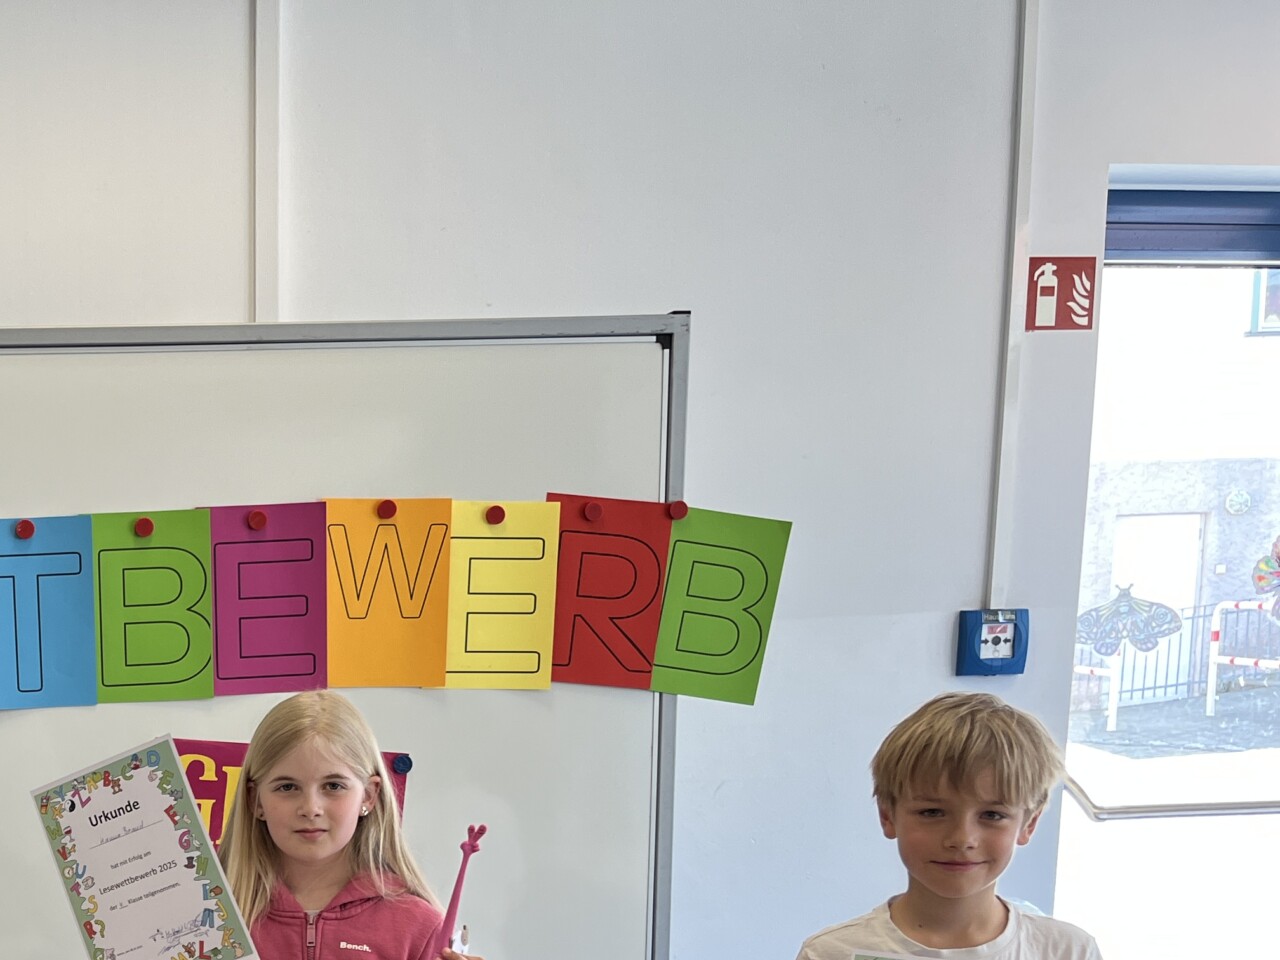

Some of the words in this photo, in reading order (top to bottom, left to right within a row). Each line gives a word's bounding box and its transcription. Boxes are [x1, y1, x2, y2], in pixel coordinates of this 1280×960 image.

[89, 800, 140, 827] Urkunde
[119, 859, 128, 867] mit
[128, 855, 143, 864] Erfolg
[143, 851, 151, 859] am
[99, 868, 157, 895] Lesewettbewerb
[159, 860, 177, 873] 2025
[128, 896, 143, 904] Klasse
